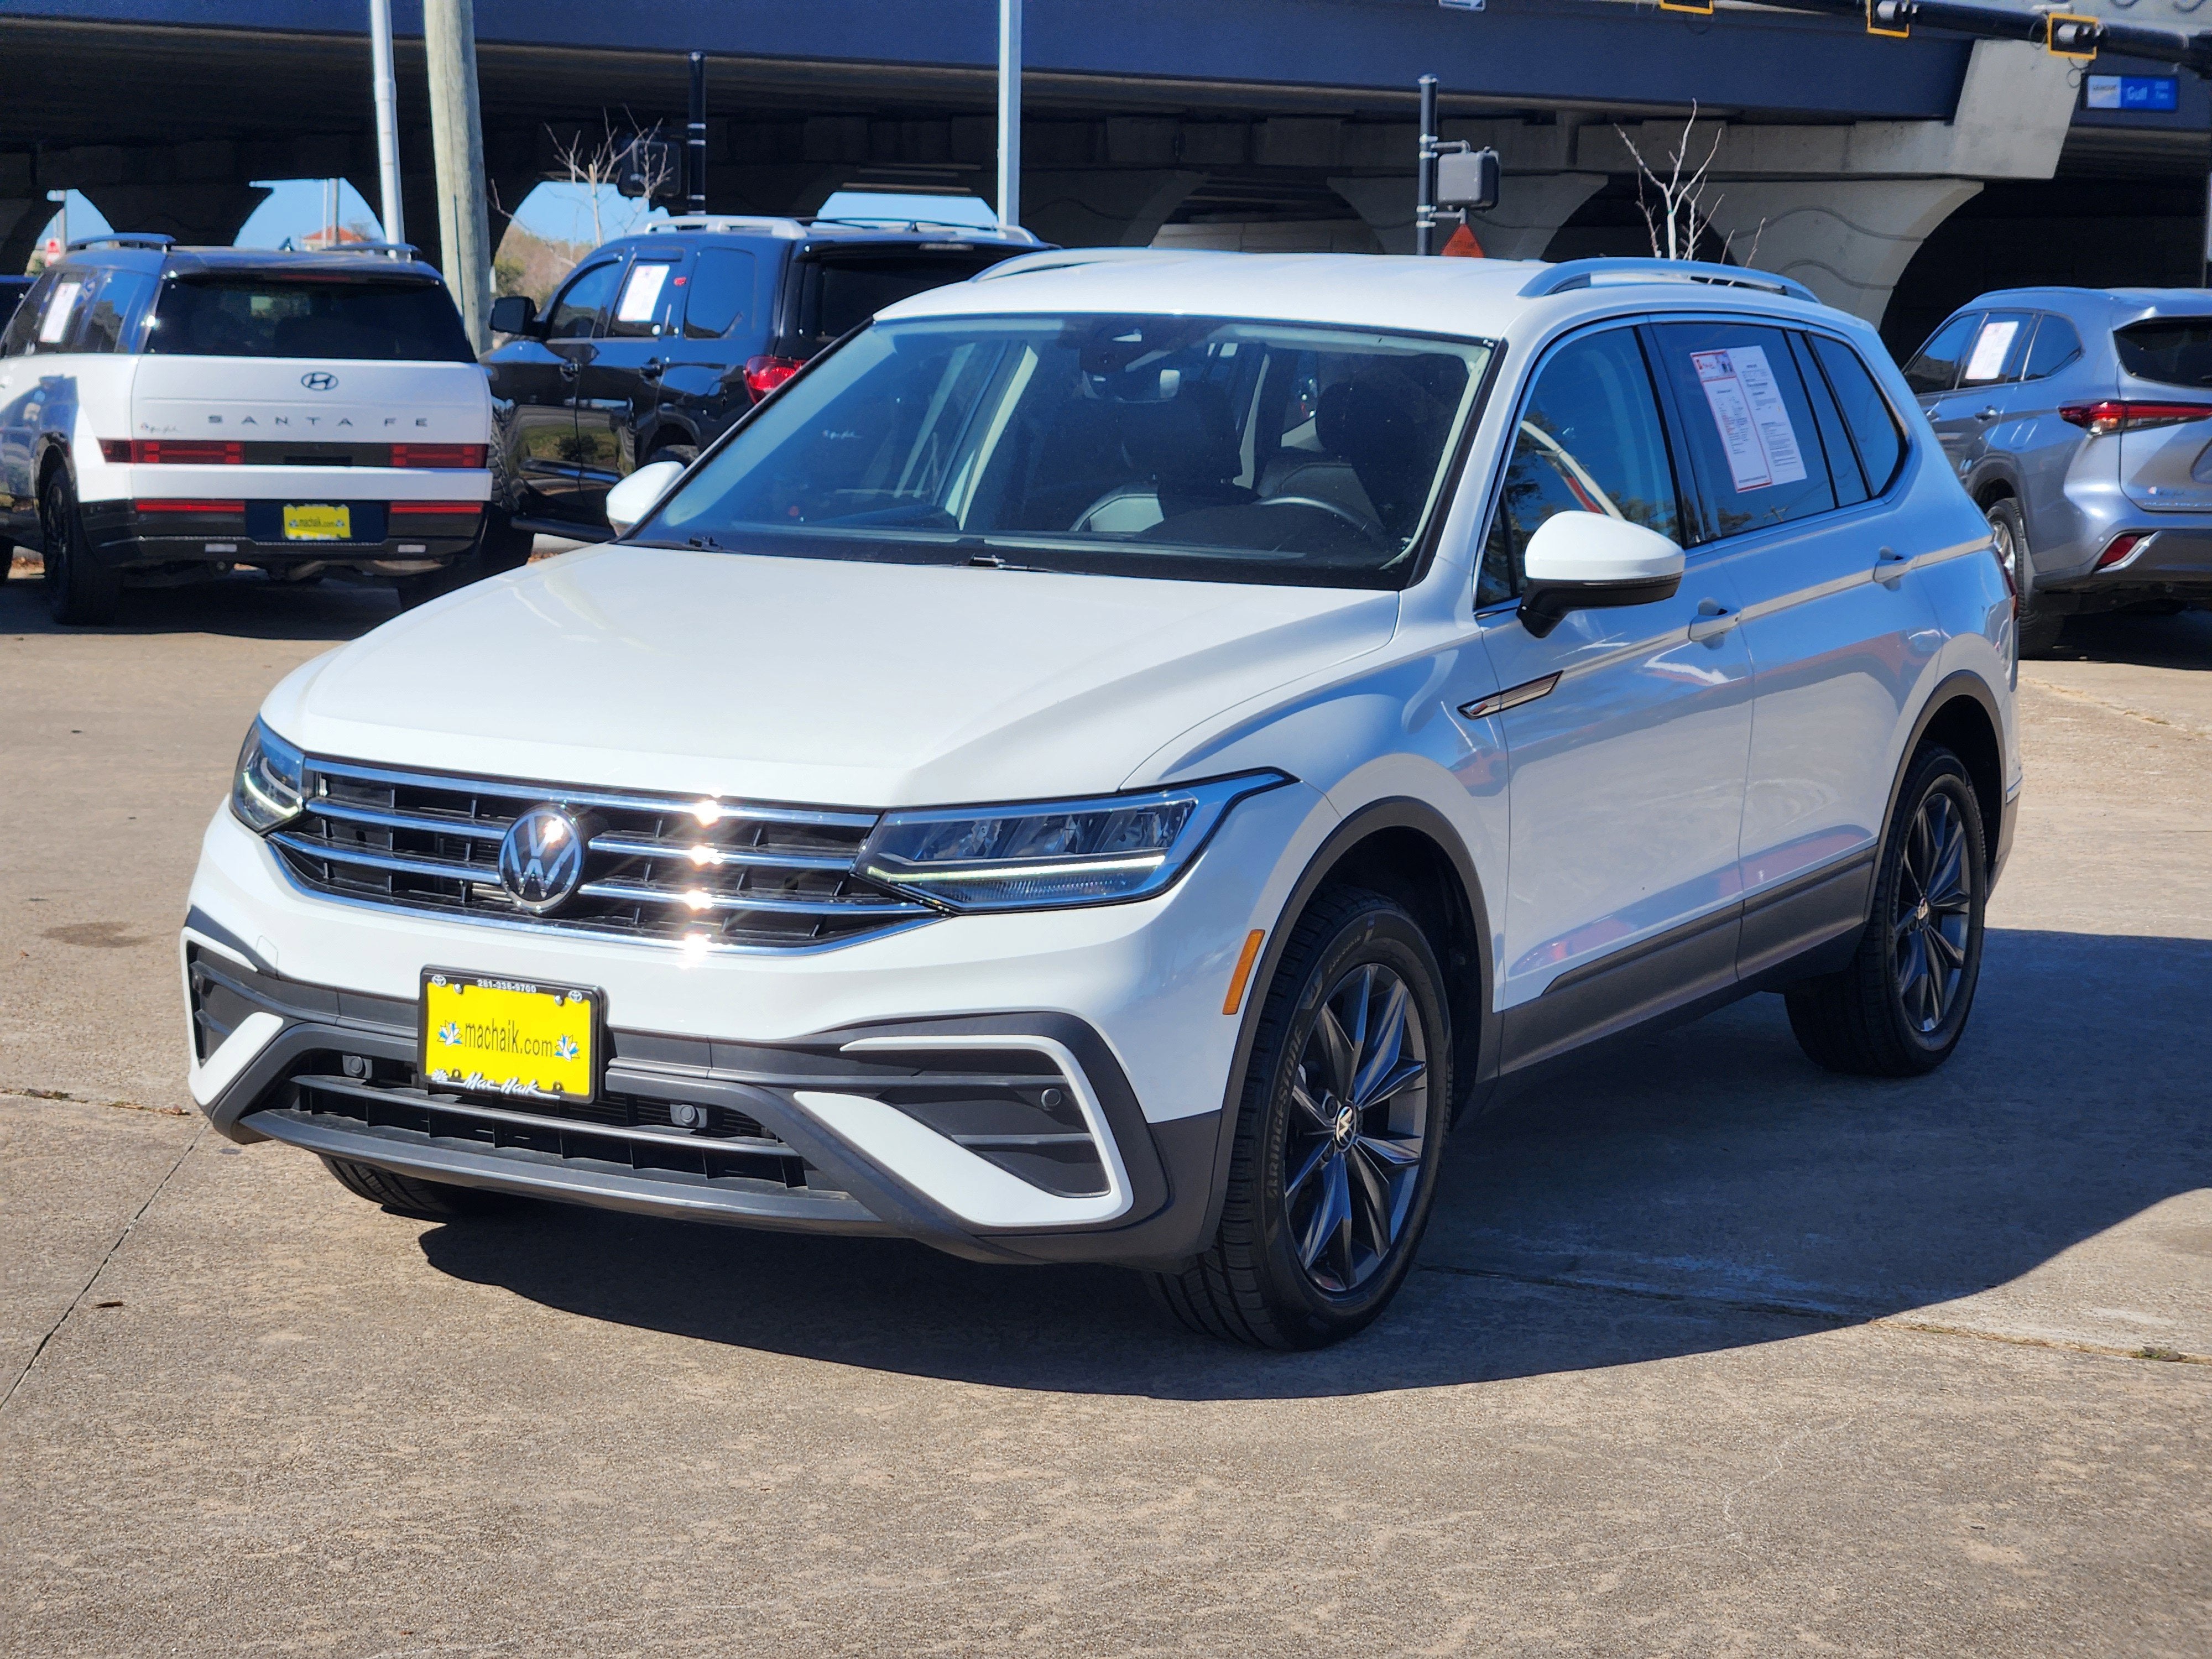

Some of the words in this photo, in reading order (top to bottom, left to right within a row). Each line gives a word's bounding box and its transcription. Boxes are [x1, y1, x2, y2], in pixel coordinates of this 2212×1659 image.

[208, 415, 353, 426] SANTA
[384, 418, 427, 427] FE
[465, 1018, 552, 1057] machaik.com
[463, 1071, 500, 1091] Mac
[500, 1077, 560, 1100] Haik
